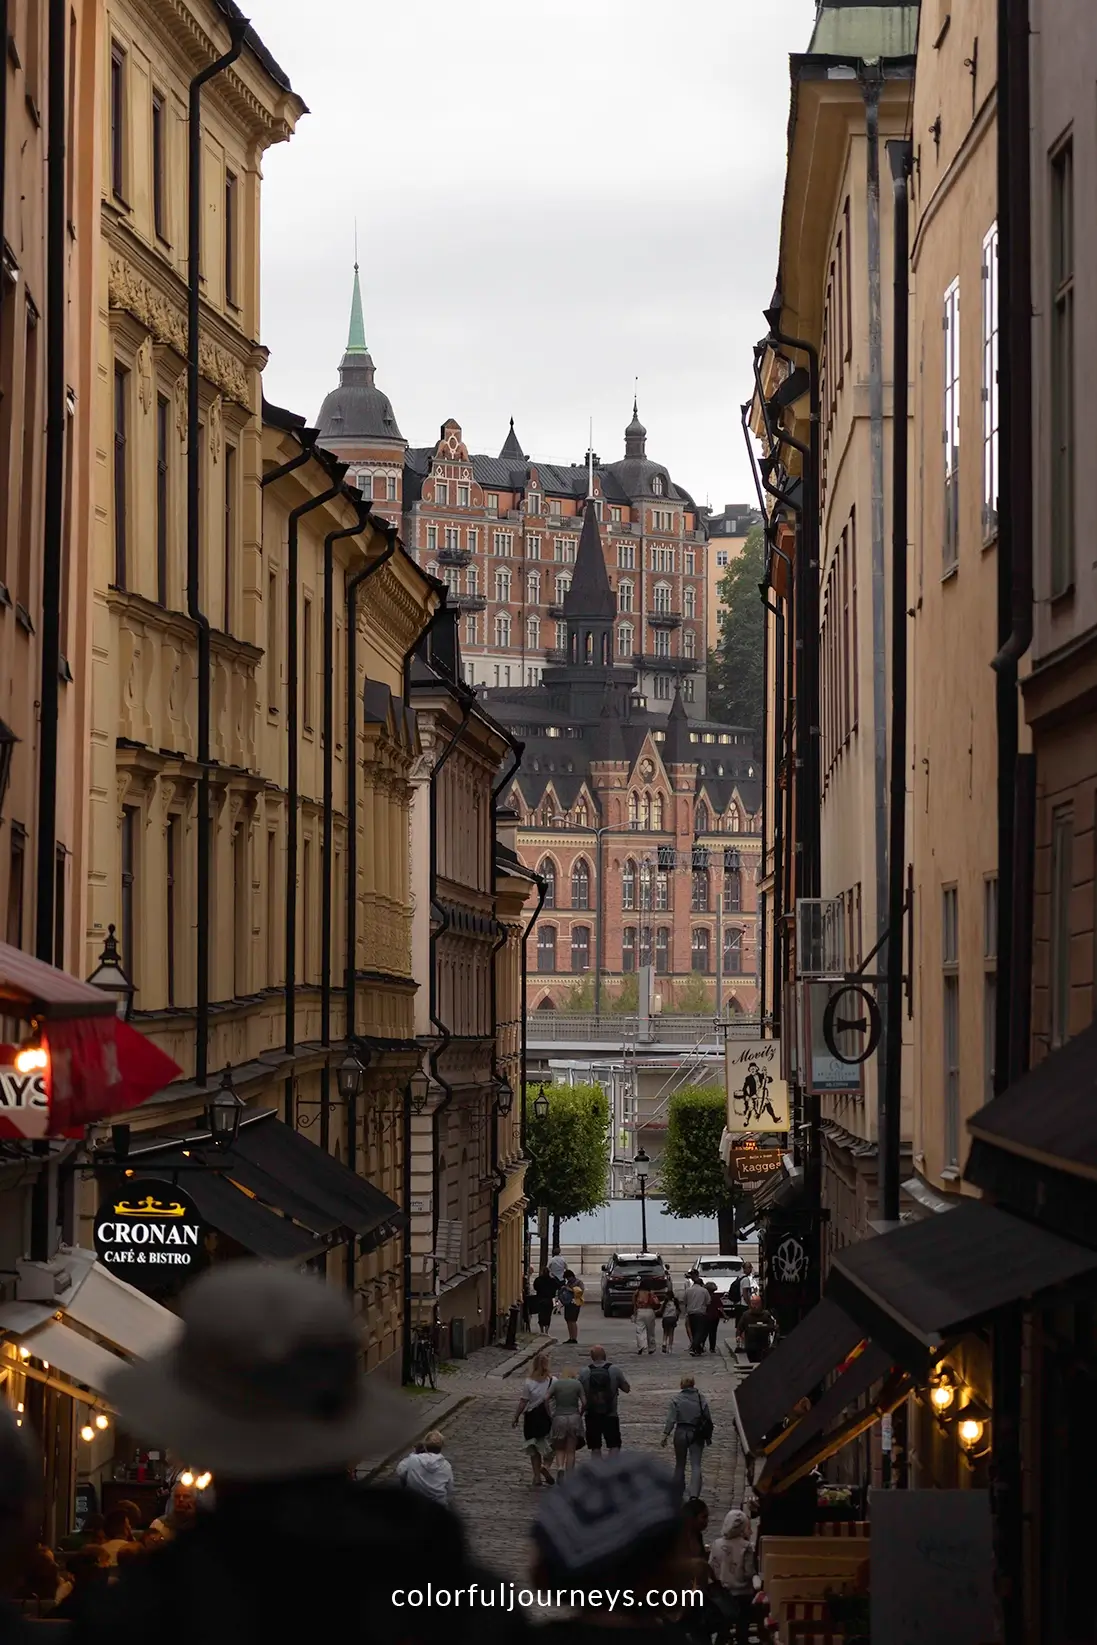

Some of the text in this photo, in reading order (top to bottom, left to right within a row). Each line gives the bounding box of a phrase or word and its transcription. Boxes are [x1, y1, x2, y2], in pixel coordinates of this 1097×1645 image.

[731, 1044, 777, 1065] Movitz
[97, 1222, 200, 1246] CRONAN
[104, 1248, 191, 1265] CAFÉ & BISTRO
